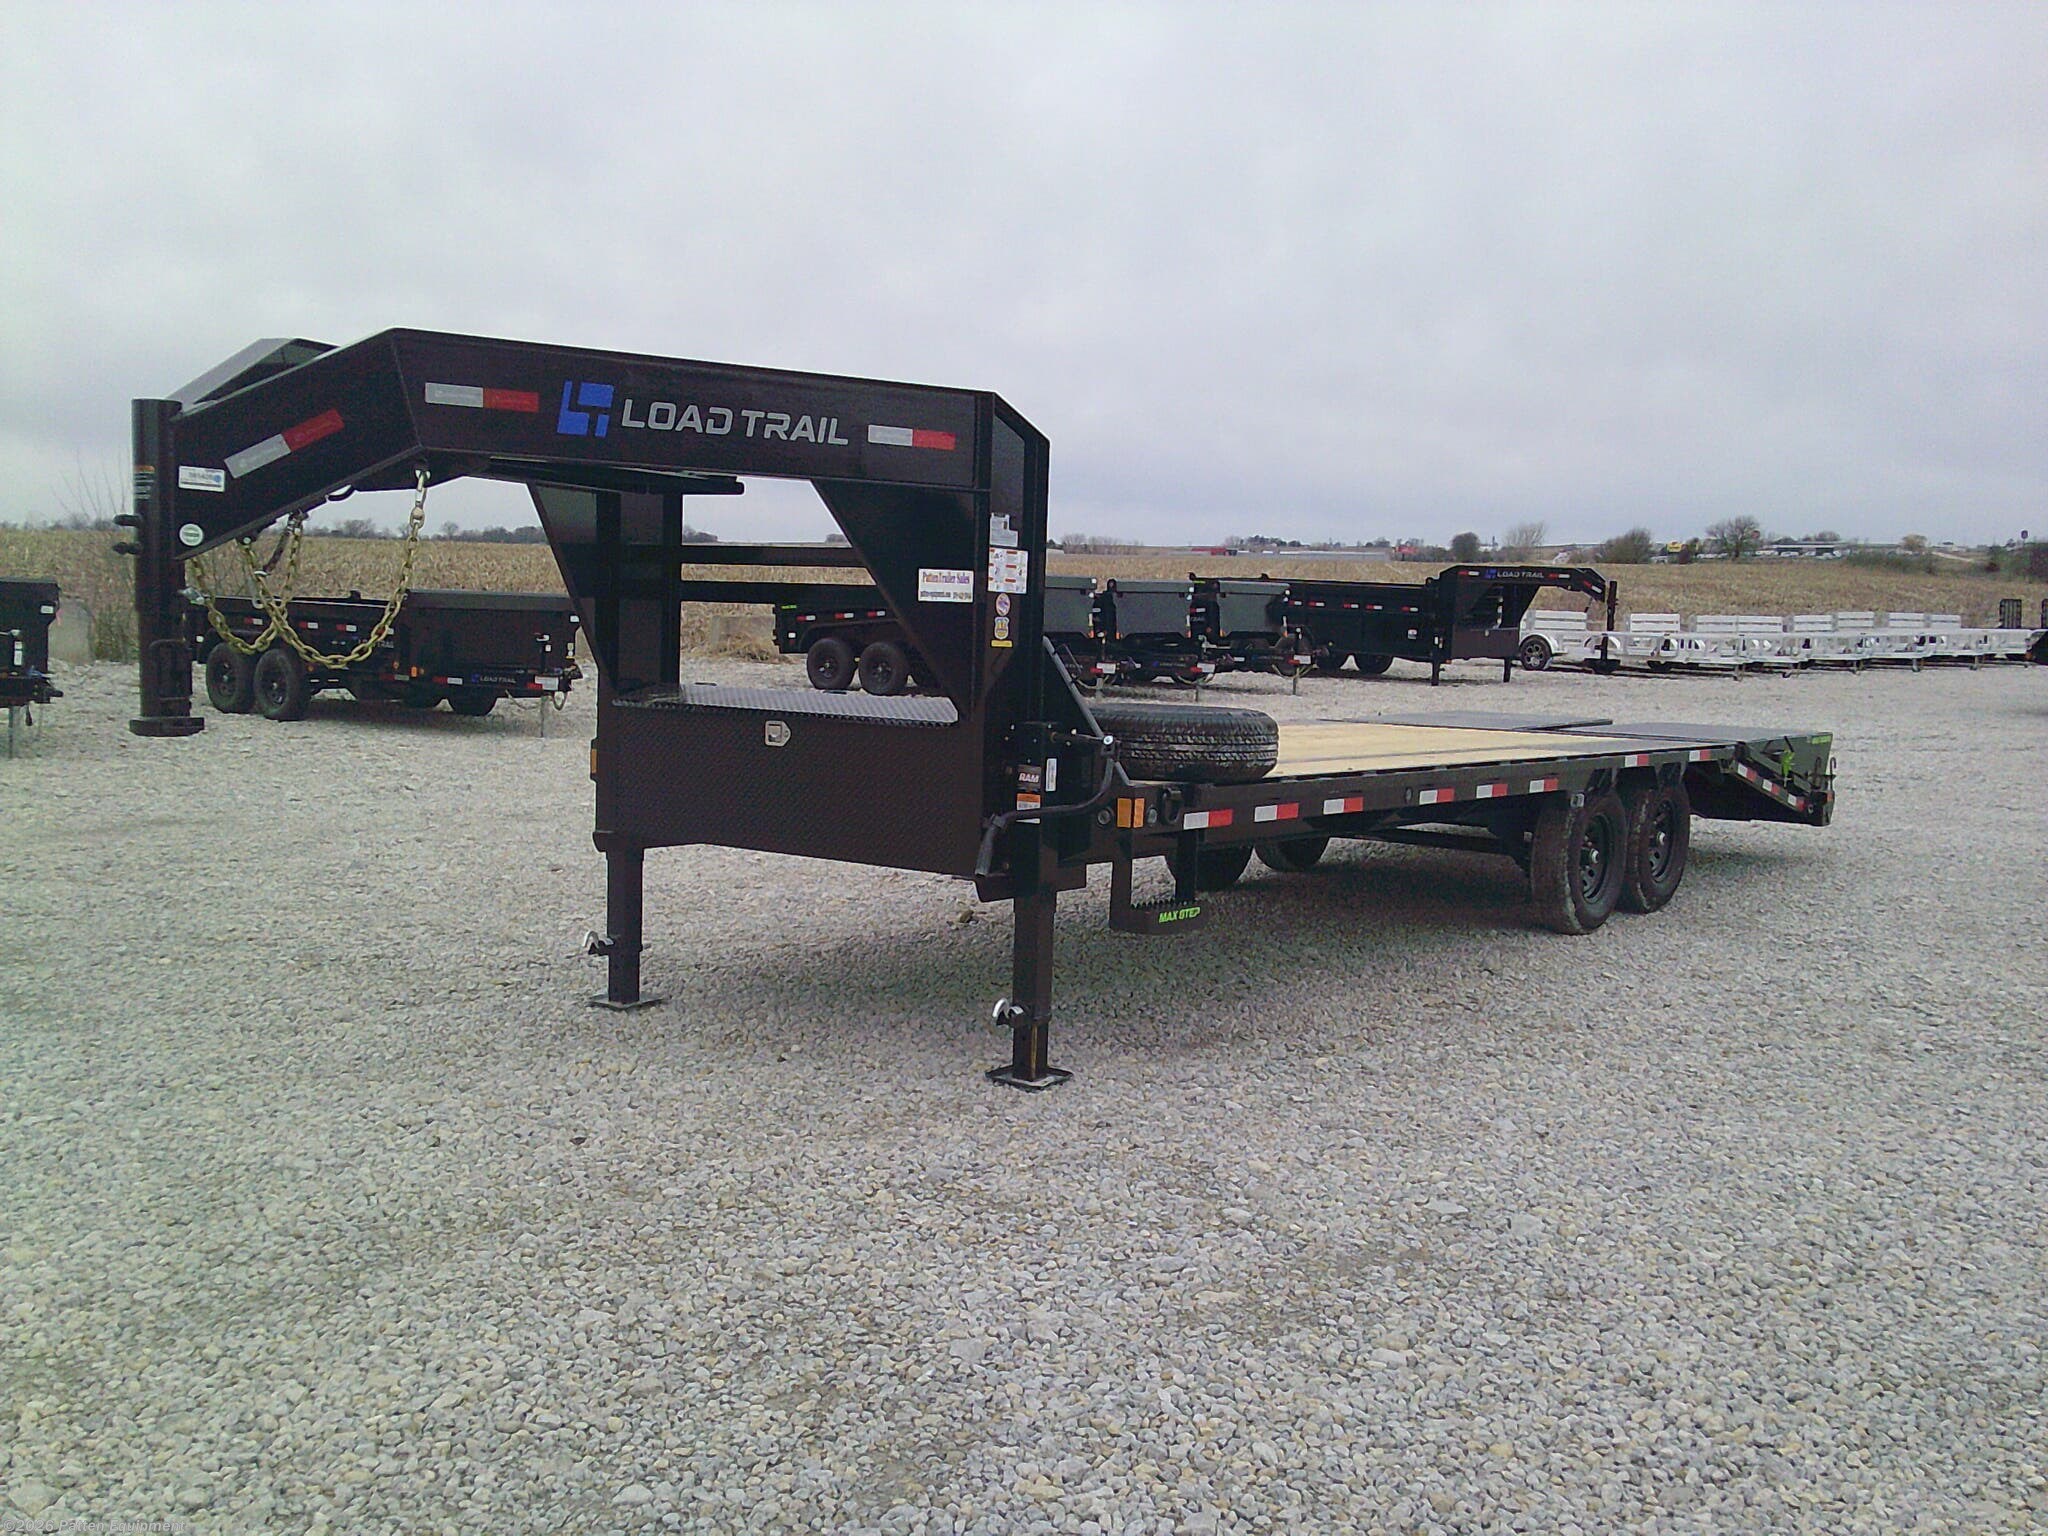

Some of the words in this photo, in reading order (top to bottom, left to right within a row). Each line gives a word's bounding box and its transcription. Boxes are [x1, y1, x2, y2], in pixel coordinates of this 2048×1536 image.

[621, 398, 734, 435] LOAD
[741, 409, 849, 446] TRAIL
[1018, 772, 1040, 783] RAM
[1159, 910, 1178, 923] MAX
